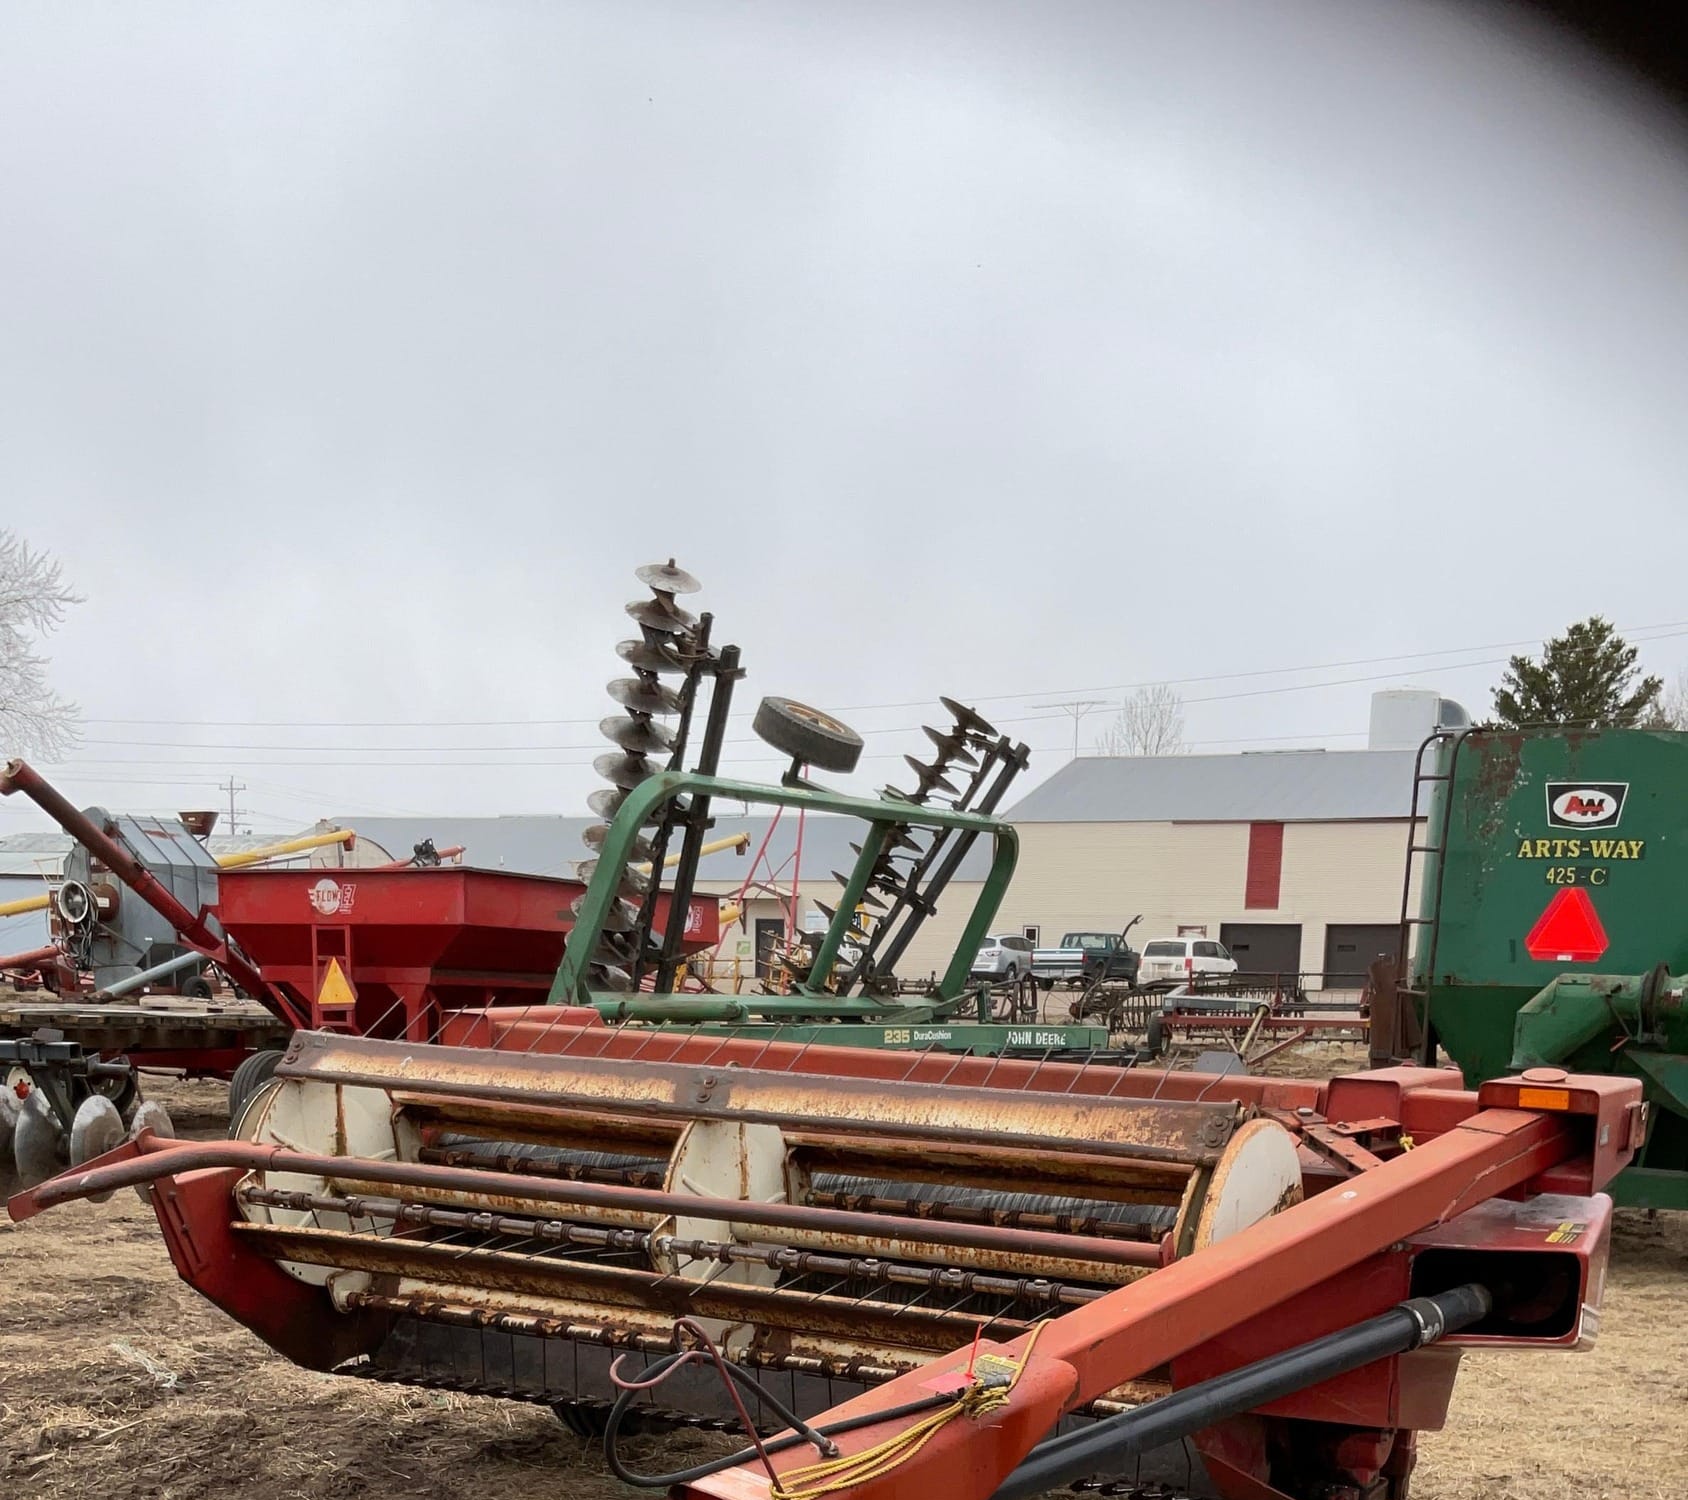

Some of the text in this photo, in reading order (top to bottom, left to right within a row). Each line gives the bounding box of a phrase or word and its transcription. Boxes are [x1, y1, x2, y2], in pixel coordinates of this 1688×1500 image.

[1563, 795, 1605, 816] AW
[1517, 839, 1644, 859] ARTS-WAY
[884, 1029, 952, 1044] 235 DuraCushion
[1007, 1031, 1067, 1046] JOHN DEERE
